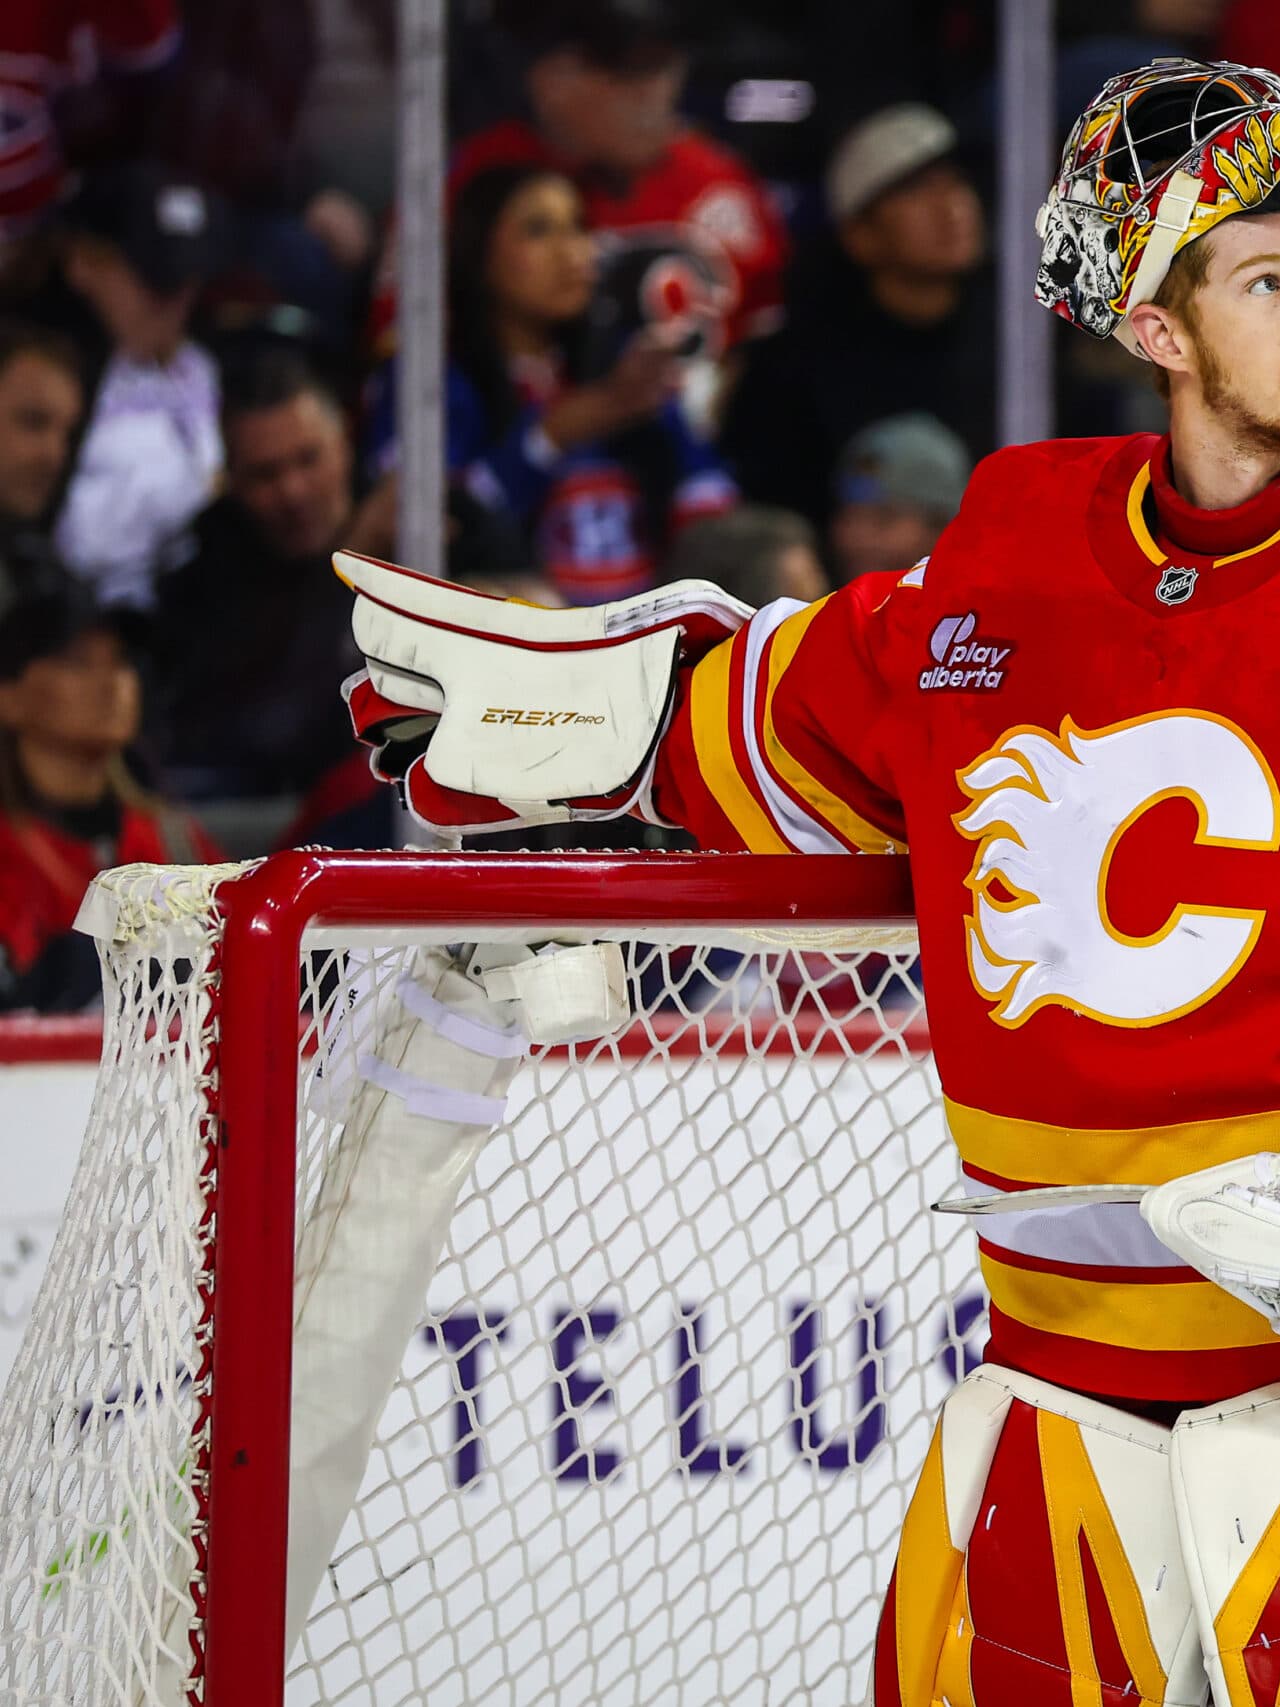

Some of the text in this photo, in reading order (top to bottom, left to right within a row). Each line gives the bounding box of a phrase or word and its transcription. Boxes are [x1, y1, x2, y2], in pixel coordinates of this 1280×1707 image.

[1163, 578, 1190, 596] NHL
[947, 641, 1011, 668] play
[919, 666, 1004, 689] alberta
